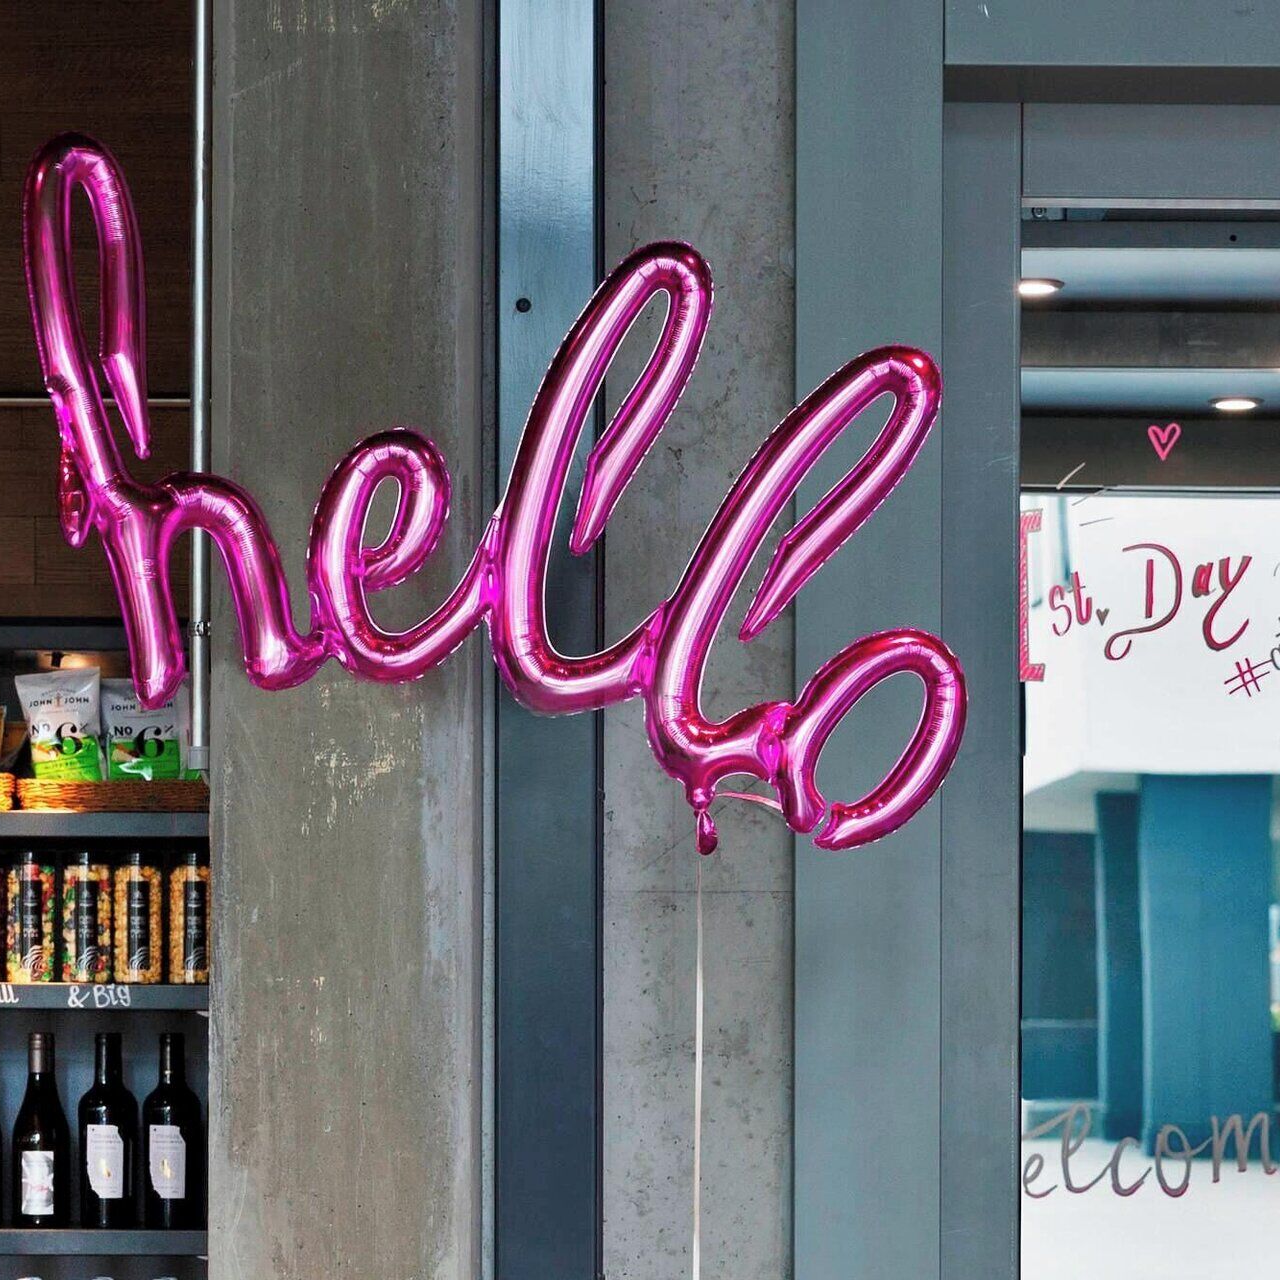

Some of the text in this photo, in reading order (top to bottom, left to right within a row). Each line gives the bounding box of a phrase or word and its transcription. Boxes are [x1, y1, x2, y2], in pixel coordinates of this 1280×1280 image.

[23, 132, 968, 852] hello
[1104, 543, 1252, 660] Day
[29, 699, 53, 707] JOHN
[110, 703, 136, 711] JOHN
[114, 725, 133, 736] NO
[67, 985, 92, 1008] &
[93, 984, 132, 1008] Big
